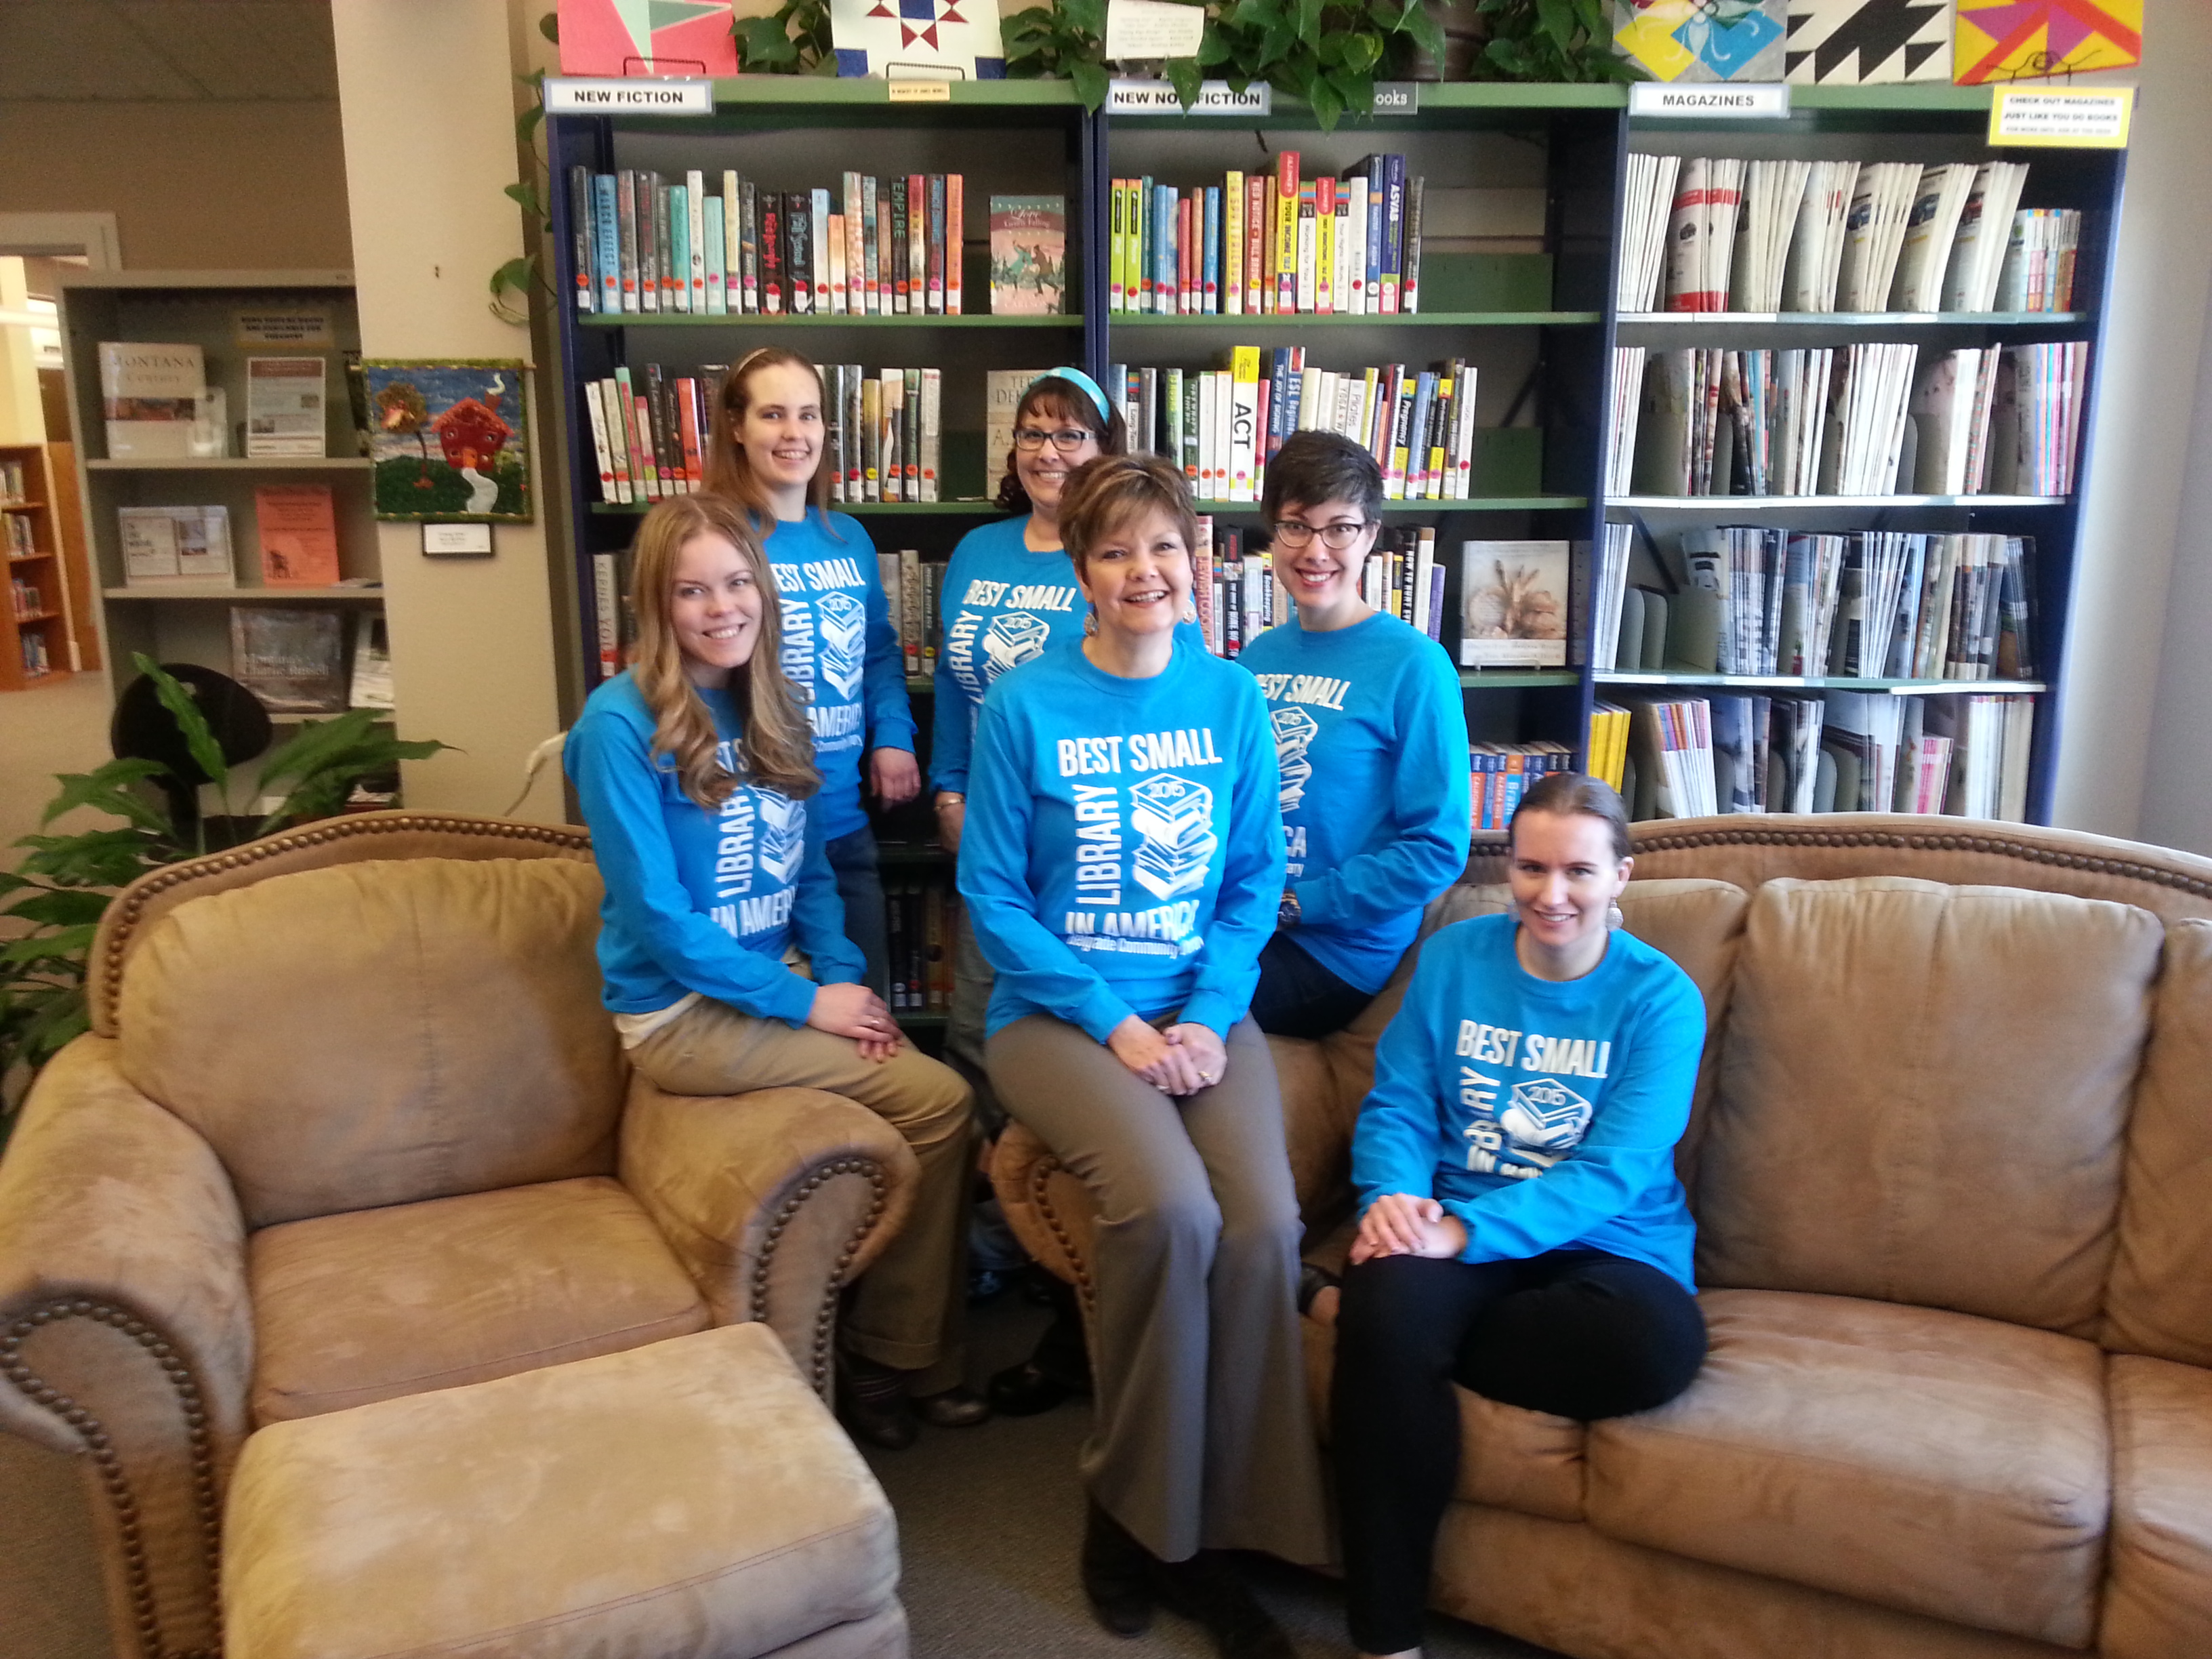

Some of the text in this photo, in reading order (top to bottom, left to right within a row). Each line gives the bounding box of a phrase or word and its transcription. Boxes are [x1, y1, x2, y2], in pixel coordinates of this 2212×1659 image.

[575, 91, 683, 103] NEW FICTION
[1113, 92, 1150, 104] NEW
[1375, 94, 1408, 106] ooks
[1662, 94, 1755, 106] MAGAZINES
[2009, 97, 2041, 105] CHECK
[893, 182, 905, 239] EMPIRE
[1389, 184, 1400, 222] ASVAB
[1251, 238, 1259, 255] BILL
[1276, 364, 1284, 377] THE
[1274, 392, 1282, 403] OF
[1275, 380, 1284, 392] JOY
[1289, 378, 1300, 396] ESL
[1349, 394, 1362, 427] Pilates
[1398, 399, 1412, 445] Pregnancy
[1235, 403, 1252, 450] ACT
[1405, 550, 1415, 571] HOW
[804, 557, 866, 592] SMALL
[1197, 558, 1210, 598] JEWISH
[1404, 572, 1413, 583] TO
[962, 579, 1078, 612] BEST SMALL
[1263, 575, 1272, 622] Bookkeeping
[1404, 585, 1412, 607] HUNT
[1256, 674, 1352, 712] EST SMALL
[1057, 728, 1223, 777] BEST SMALL
[1146, 781, 1186, 798] 2015
[714, 790, 756, 899] LIBRAR
[1071, 784, 1122, 905] LIBRARY
[1065, 912, 1096, 935] IN
[1455, 1019, 1611, 1079] BEST SMALL
